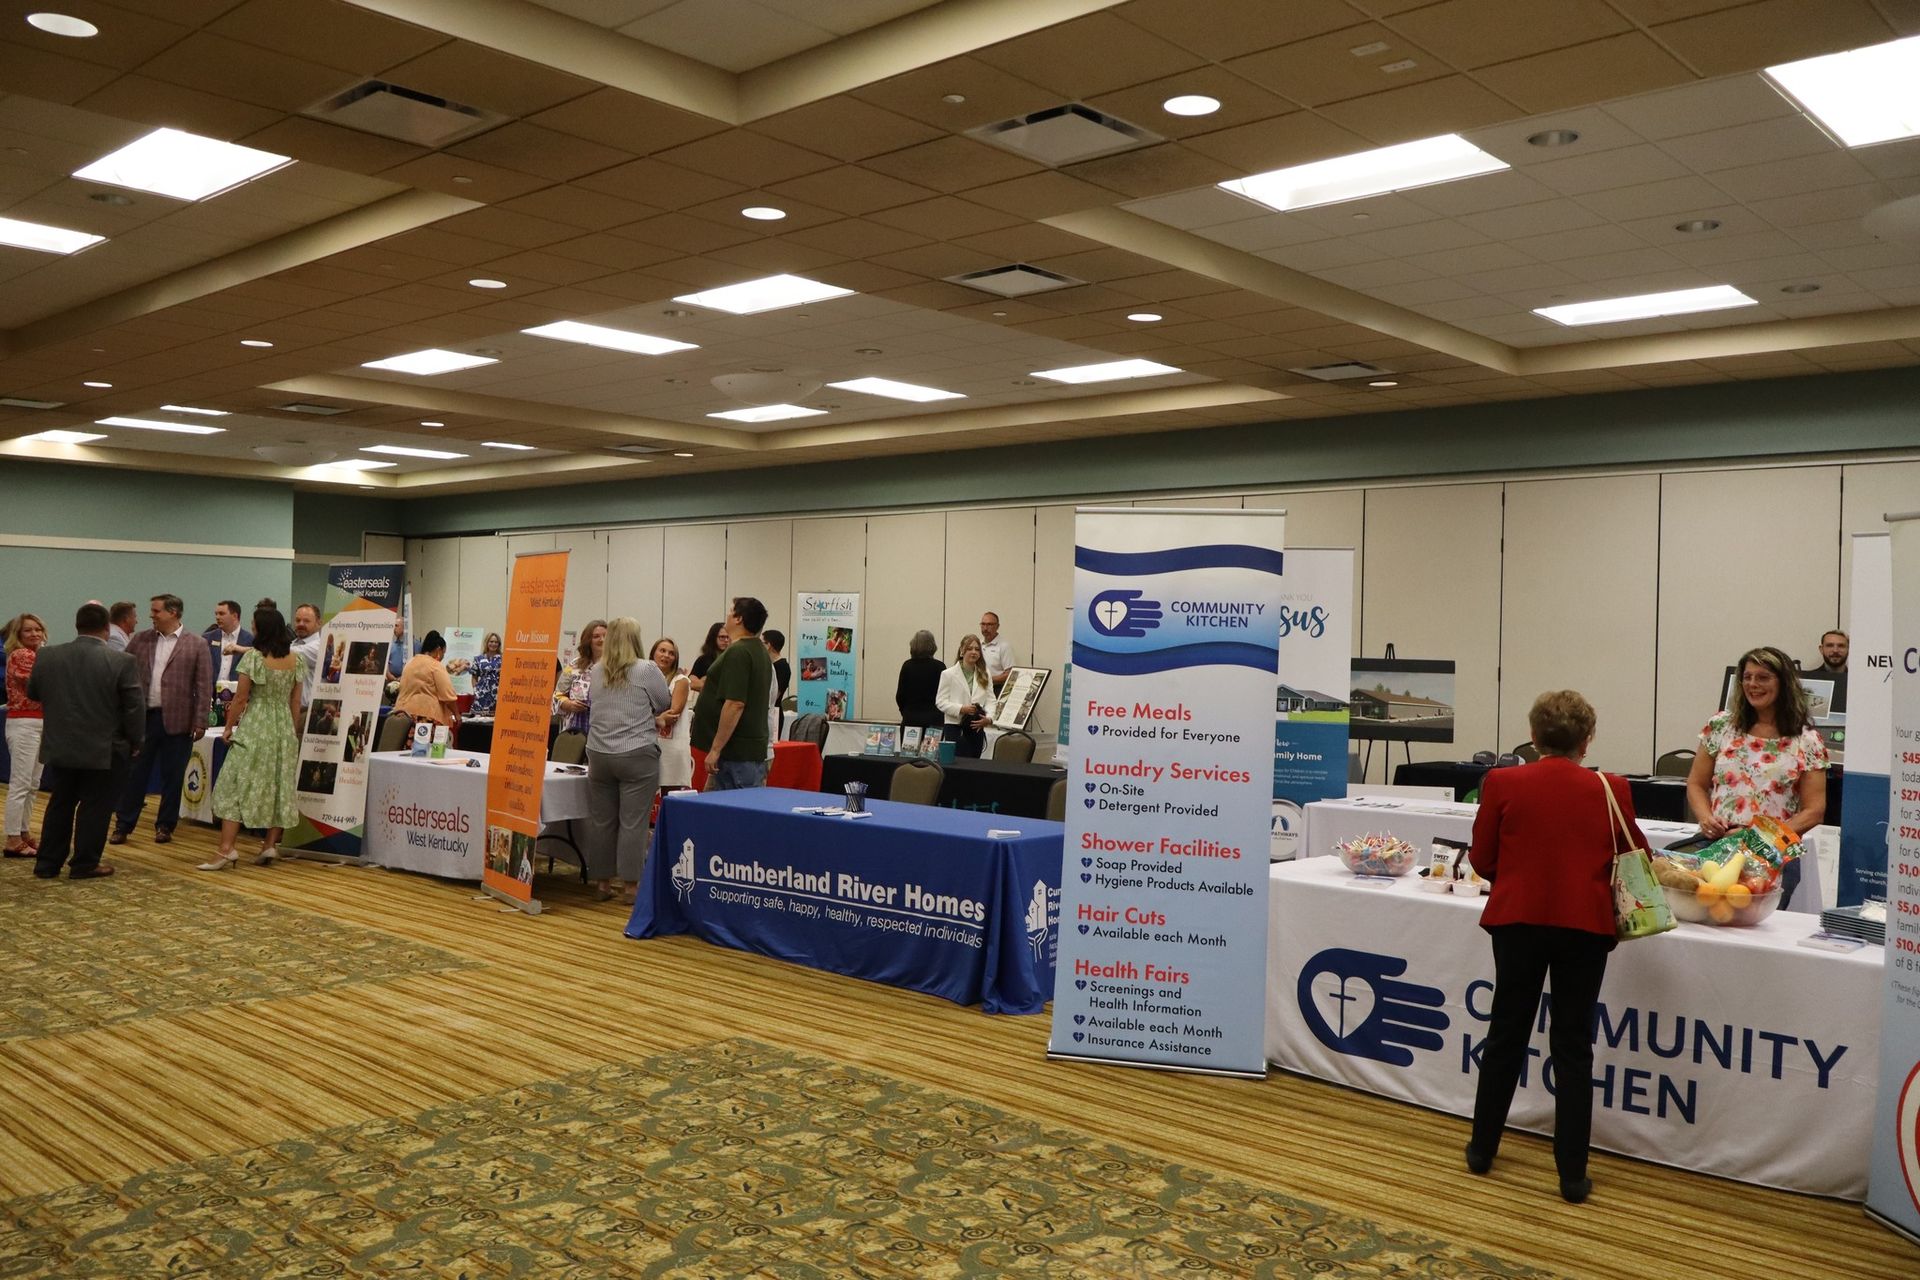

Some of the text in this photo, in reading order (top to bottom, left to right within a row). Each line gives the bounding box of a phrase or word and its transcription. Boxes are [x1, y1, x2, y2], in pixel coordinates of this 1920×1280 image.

[343, 576, 390, 589] easterseals
[520, 577, 565, 594] easterseals
[365, 590, 389, 599] Kentucky
[1171, 601, 1265, 615] COMMUNITY
[328, 621, 394, 630] Employment Opportunities
[1186, 615, 1249, 628] KITCHEN
[1279, 605, 1330, 638] sus
[516, 630, 530, 643] Our
[1904, 647, 1920, 674] C
[1088, 701, 1192, 721] Free Meals
[1102, 725, 1240, 745] Provided for Everyone
[1895, 726, 1912, 738] Your
[1274, 752, 1322, 761] mily Home
[1085, 758, 1164, 783] Laundry
[1170, 762, 1251, 783] Services
[1100, 783, 1145, 796] On-Site
[1901, 789, 1920, 801] $27
[1099, 799, 1218, 817] Detergent Provided
[1900, 806, 1912, 820] for
[388, 803, 470, 833] easterseals
[406, 830, 469, 857] West Kentucky
[1081, 832, 1241, 860] Shower Facilities
[1899, 844, 1910, 857] for
[1096, 857, 1182, 874] Soap Provided
[1898, 863, 1920, 878] $1,0
[709, 855, 985, 922] Cumberland River Homes
[1095, 873, 1254, 896] Hygiene Products Available
[1897, 882, 1920, 896] indiv
[1078, 903, 1166, 926] Hair Cuts
[1897, 900, 1920, 915] $5,0
[709, 886, 983, 949] Supporting safe, happy, healthy, respected individuals
[1093, 926, 1227, 947] Available each Month
[1075, 959, 1190, 984] Health Fairs
[1895, 956, 1905, 968] of
[1907, 958, 1913, 971] 8
[1090, 981, 1182, 999] Screenings and
[1089, 996, 1202, 1017] Health Information
[1088, 1016, 1223, 1039] Available each Month
[1465, 979, 1848, 1089] CMUNITY
[1088, 1033, 1212, 1055] Insurance Assistance
[1461, 1033, 1697, 1125] KTCHEN
